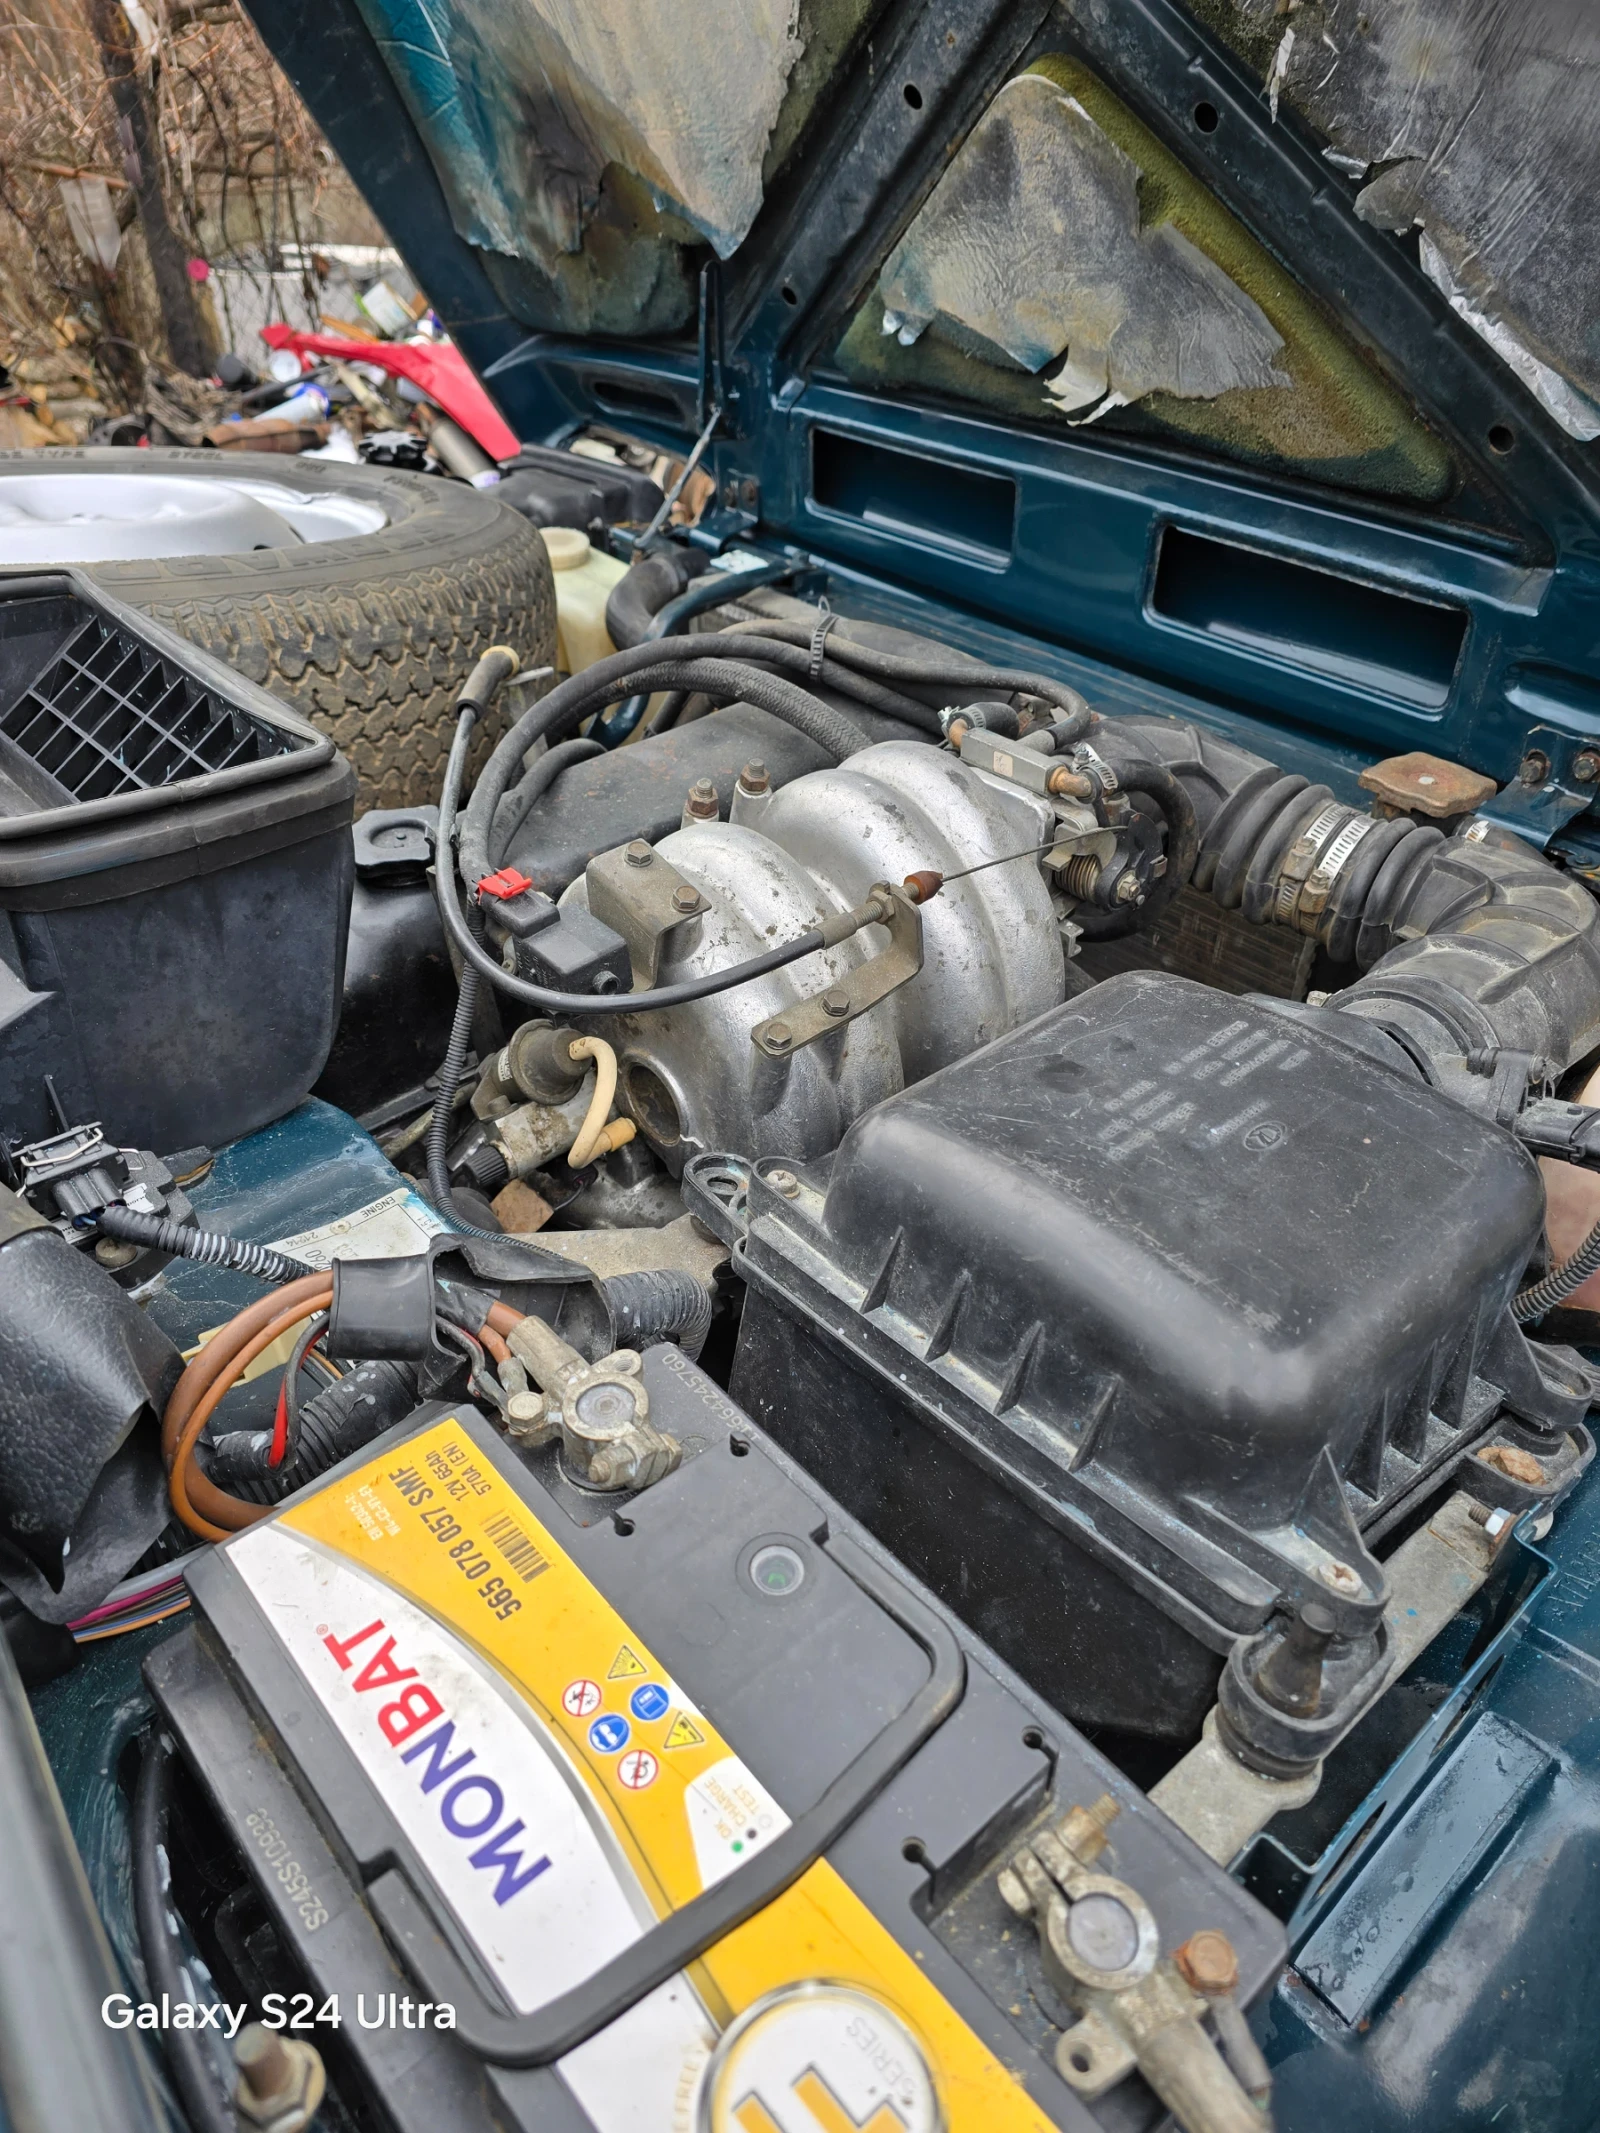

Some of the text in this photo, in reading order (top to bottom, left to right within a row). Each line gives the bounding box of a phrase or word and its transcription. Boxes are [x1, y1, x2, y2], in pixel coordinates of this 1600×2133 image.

[286, 1196, 396, 1246] ENGINE 21214
[425, 1451, 469, 1501] 12V 65Ah
[442, 1442, 492, 1496] 570A (EN)
[367, 1526, 383, 1540] EN
[388, 1466, 522, 1620] 565 078 057 SMF
[323, 1619, 552, 1907] MONBAT
[704, 1777, 746, 1827] CHARGE
[732, 1785, 758, 1815] TEST
[715, 1819, 732, 1838] OK
[846, 2016, 917, 2099] SERIES
